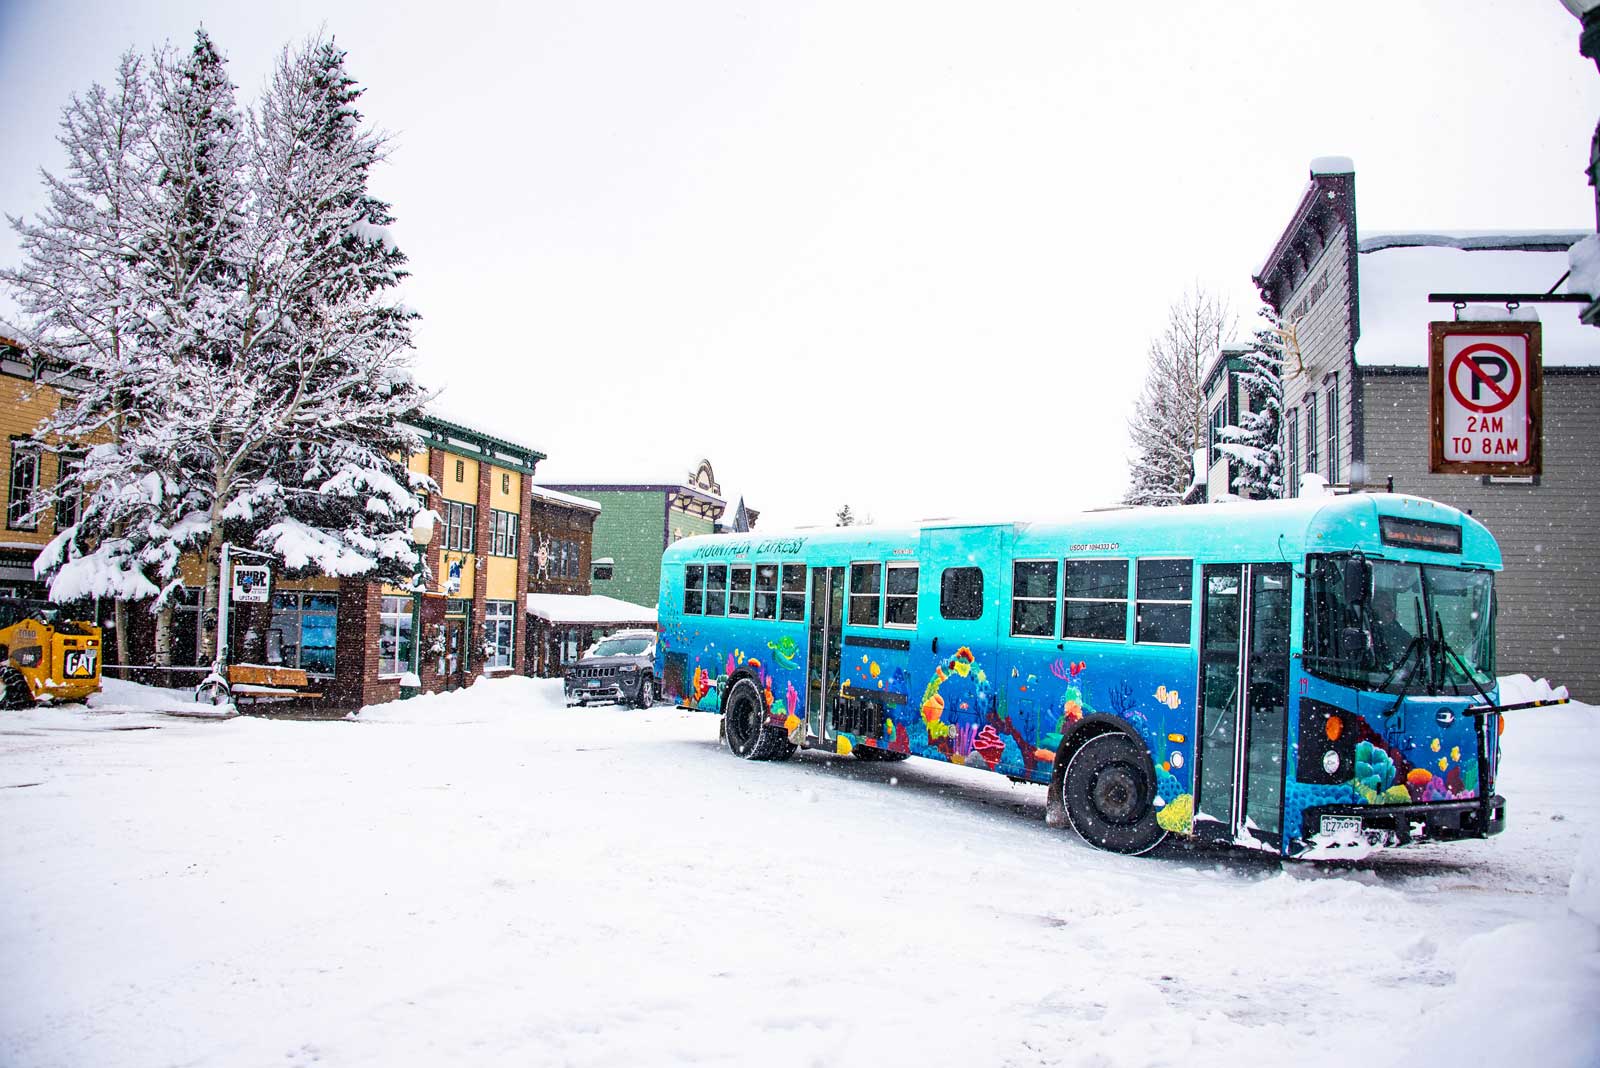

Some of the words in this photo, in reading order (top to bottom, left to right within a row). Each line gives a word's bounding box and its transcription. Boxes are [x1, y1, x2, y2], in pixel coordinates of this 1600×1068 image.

[1471, 356, 1508, 400] P
[1467, 416, 1503, 433] 2AM
[1452, 437, 1472, 454] TO
[1482, 438, 1518, 454] 8AM
[693, 541, 751, 558] MOUNTAIN
[756, 537, 808, 554] EXPRESS
[66, 653, 95, 676] CAT
[1299, 678, 1308, 695] 19
